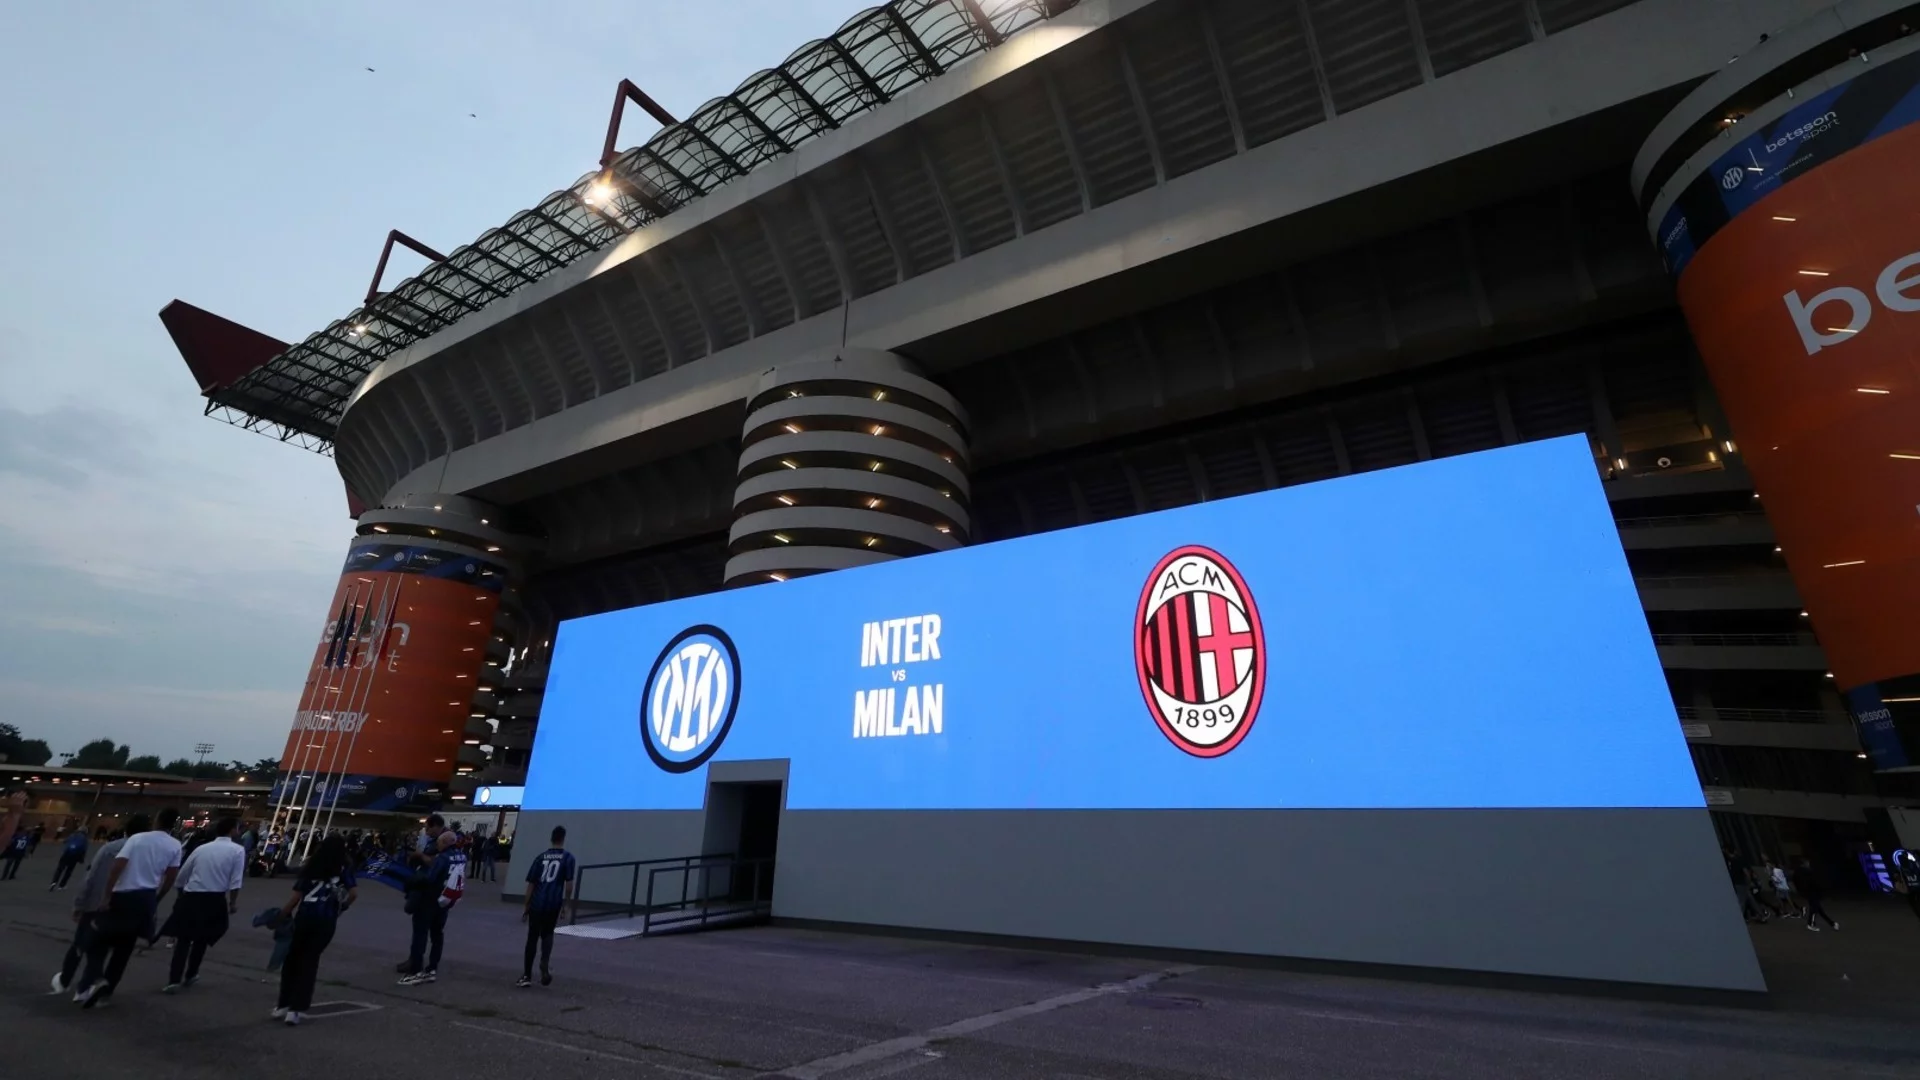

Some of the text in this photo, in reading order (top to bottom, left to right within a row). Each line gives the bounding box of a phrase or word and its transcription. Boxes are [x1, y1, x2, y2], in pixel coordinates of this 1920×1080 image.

[1766, 111, 1837, 153] betsson
[1159, 561, 1226, 600] ACM
[861, 613, 942, 667] INTER
[891, 669, 906, 682] VS
[852, 683, 944, 739] MILAN
[1174, 703, 1236, 729] 1899
[540, 859, 561, 884] 10
